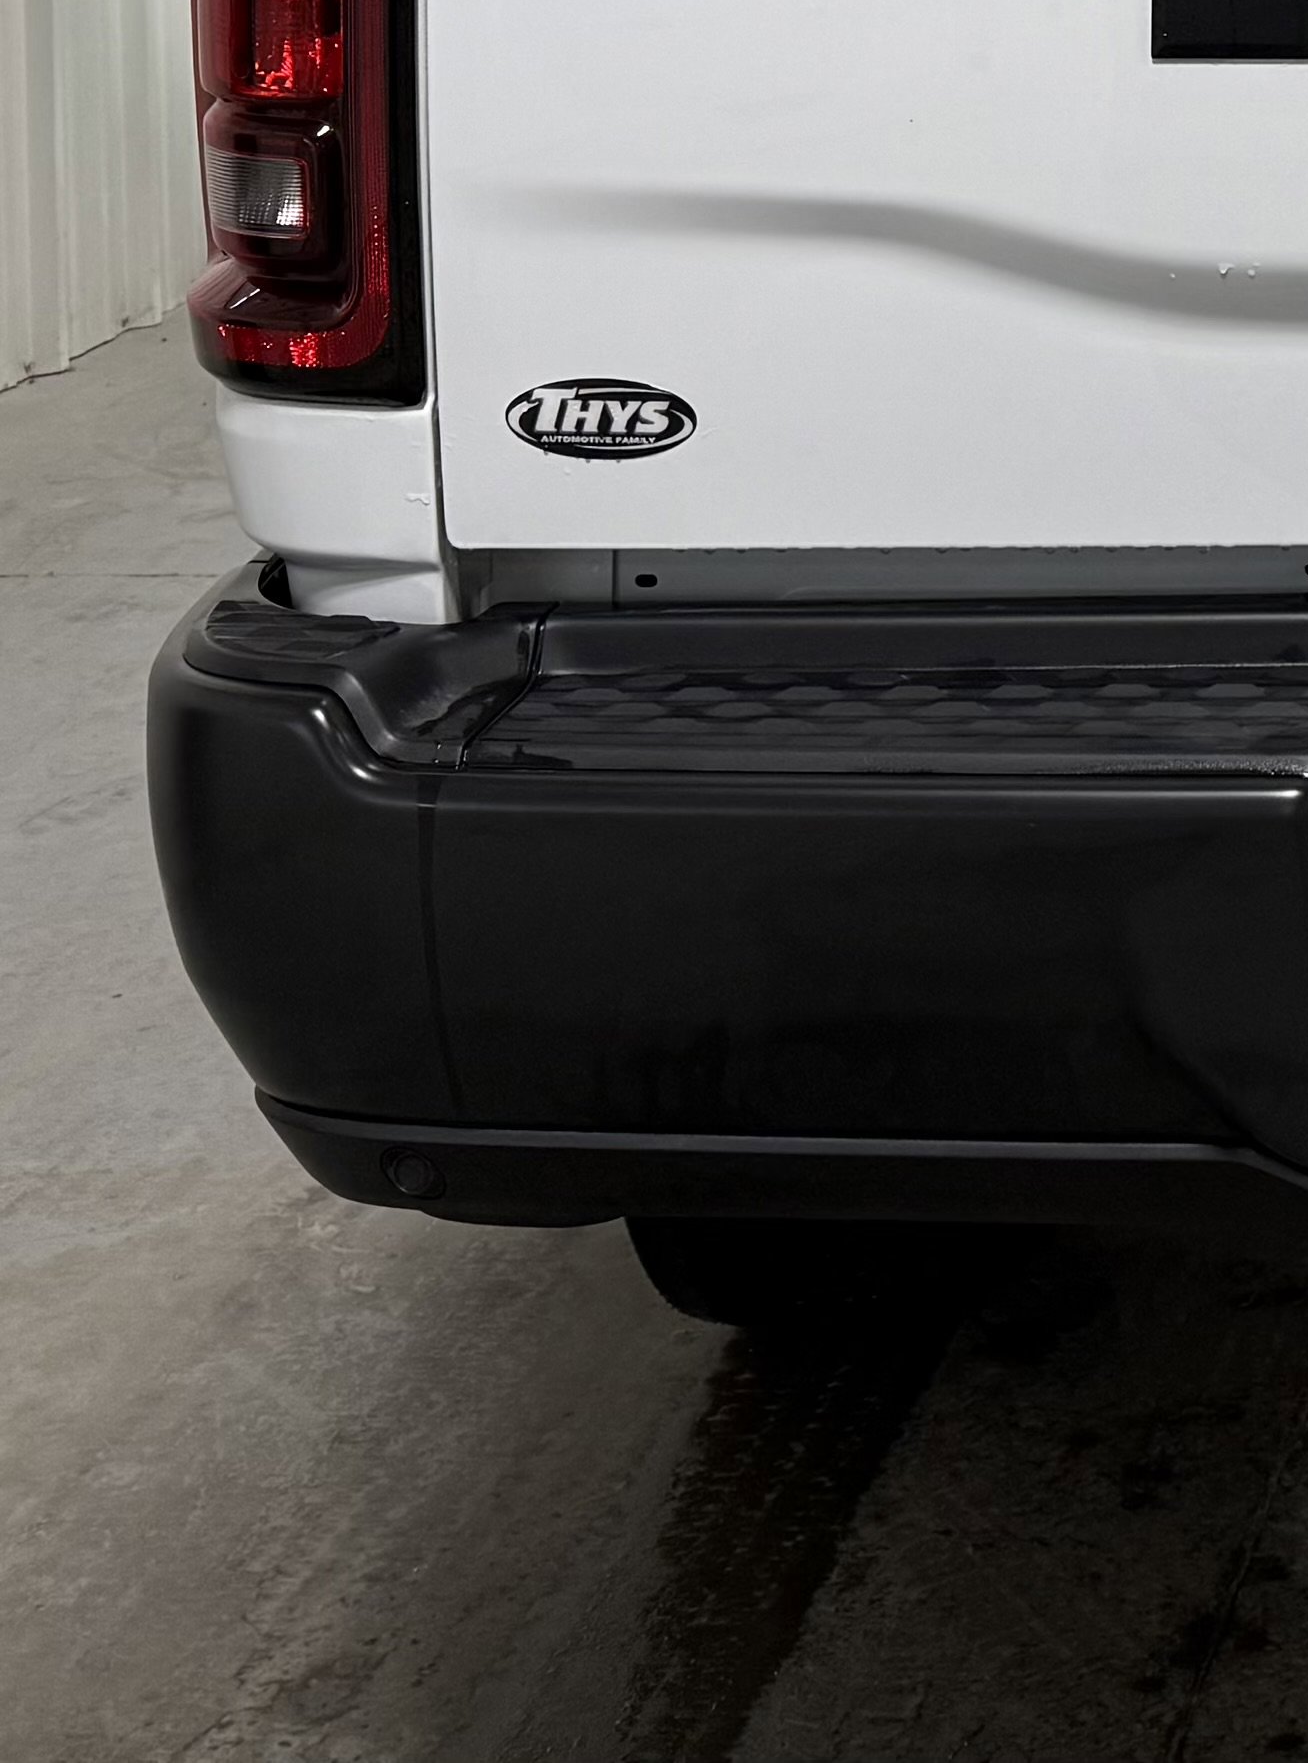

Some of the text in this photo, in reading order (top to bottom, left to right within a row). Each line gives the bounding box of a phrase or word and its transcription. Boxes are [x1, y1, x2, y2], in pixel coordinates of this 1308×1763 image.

[531, 387, 671, 434] THYS
[540, 435, 656, 445] AUTOMOTIVE FAMILY
